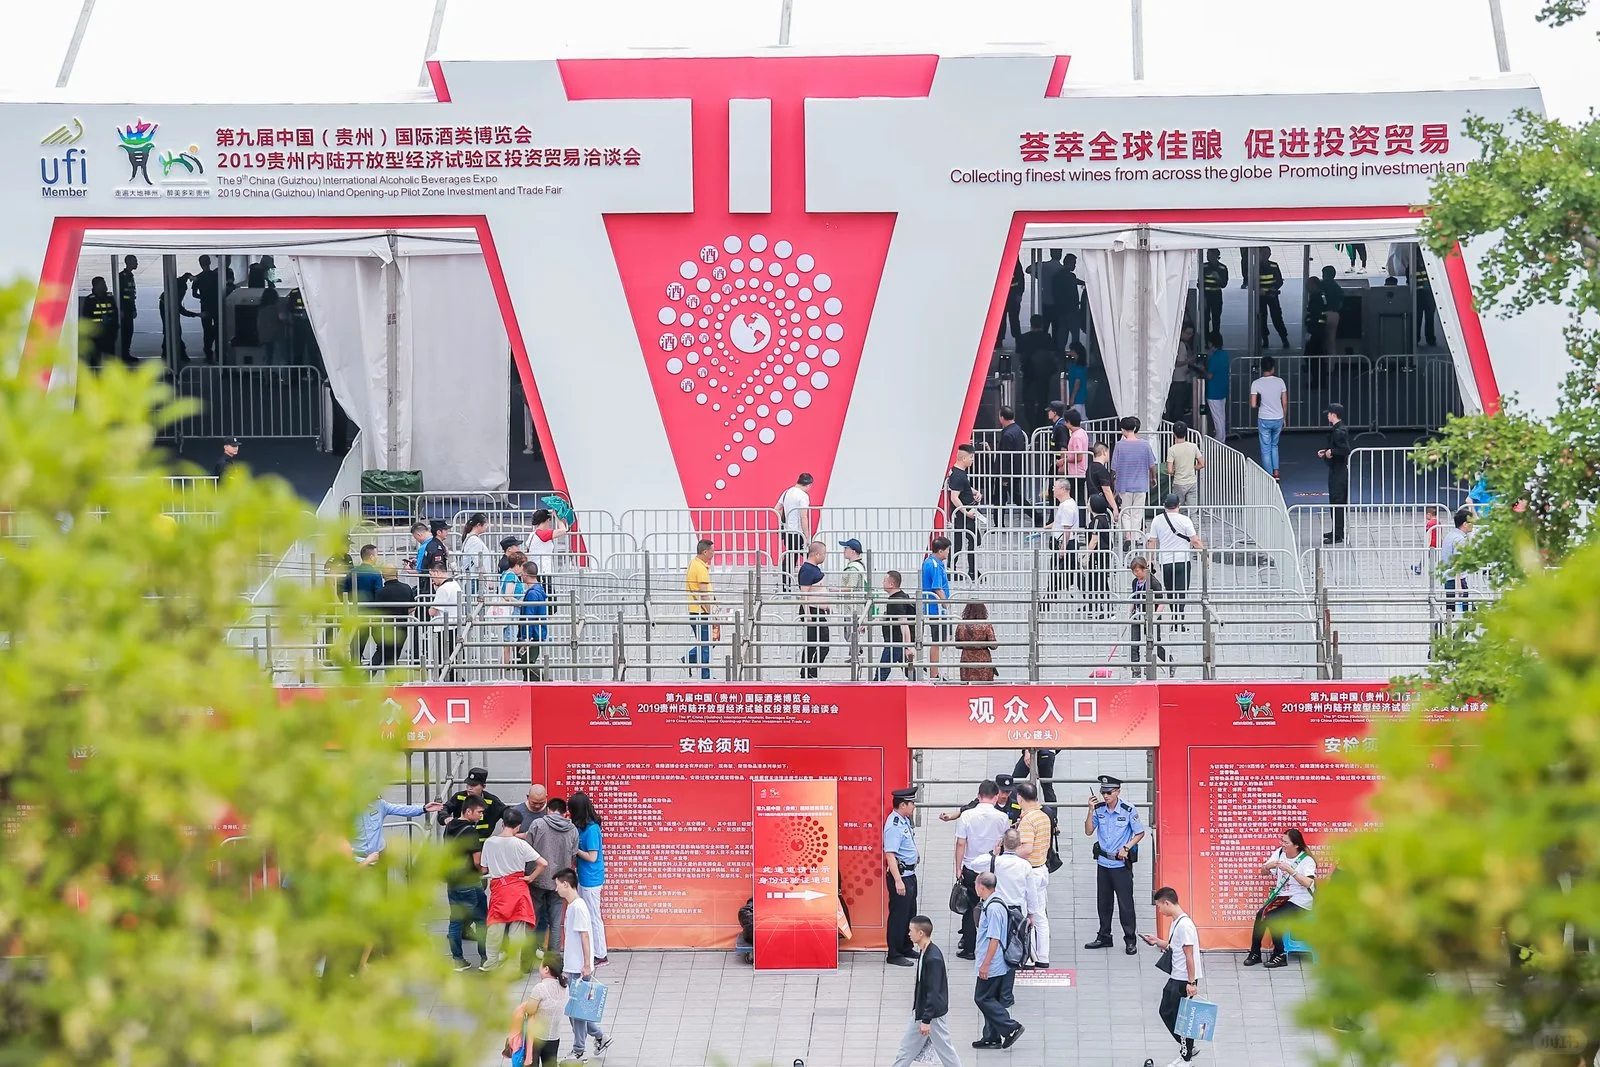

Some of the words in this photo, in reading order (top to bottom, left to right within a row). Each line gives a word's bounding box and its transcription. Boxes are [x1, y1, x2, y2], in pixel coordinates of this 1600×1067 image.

[216, 125, 532, 147] 第九届中国（贵州）国际酒类博览会
[1019, 129, 1223, 163] 荟萃全球佳酿
[1244, 124, 1450, 159] 促进投资贸易
[41, 149, 87, 184] ufi
[217, 147, 641, 170] 2019贵州内陆开放型经济试验区投资贸易洽谈会
[217, 176, 235, 185] The
[249, 176, 275, 185] China
[277, 175, 321, 186] (Guizhou)
[323, 175, 377, 185] International
[380, 175, 419, 184] Alcoholic
[421, 175, 471, 186] Beverages
[473, 174, 498, 184] Expo
[950, 169, 1022, 186] Collecting
[1025, 168, 1065, 182] finest
[1069, 168, 1111, 182] wines
[1115, 167, 1148, 181] from
[1152, 168, 1201, 181] across
[1205, 166, 1228, 179] the
[1230, 165, 1272, 182] globe
[1279, 163, 1357, 180] Promoting
[1361, 161, 1443, 176] investment
[1446, 160, 1473, 173] an
[42, 187, 87, 198] Member
[217, 188, 240, 197] 2019
[243, 188, 269, 197] China
[271, 188, 315, 198] (Guizhou)
[317, 188, 344, 197] Inland
[346, 187, 399, 198] Opening-up
[401, 187, 420, 196] Pilot
[422, 187, 445, 196] Zone
[447, 186, 497, 196] Investment
[499, 186, 515, 195] and
[517, 186, 543, 195] Trade
[545, 185, 562, 194] Fair
[665, 692, 811, 703] 第九届中国（贵州）国际酒类博览会
[379, 697, 471, 725] 众入口
[637, 703, 839, 714] 2019贵州内陆开放型经济试验区投资贸易洽谈会
[968, 695, 1098, 724] 观众入口
[381, 730, 432, 742] （小碰头）
[679, 737, 750, 753] 安检须知
[1324, 737, 1378, 753] 安检须
